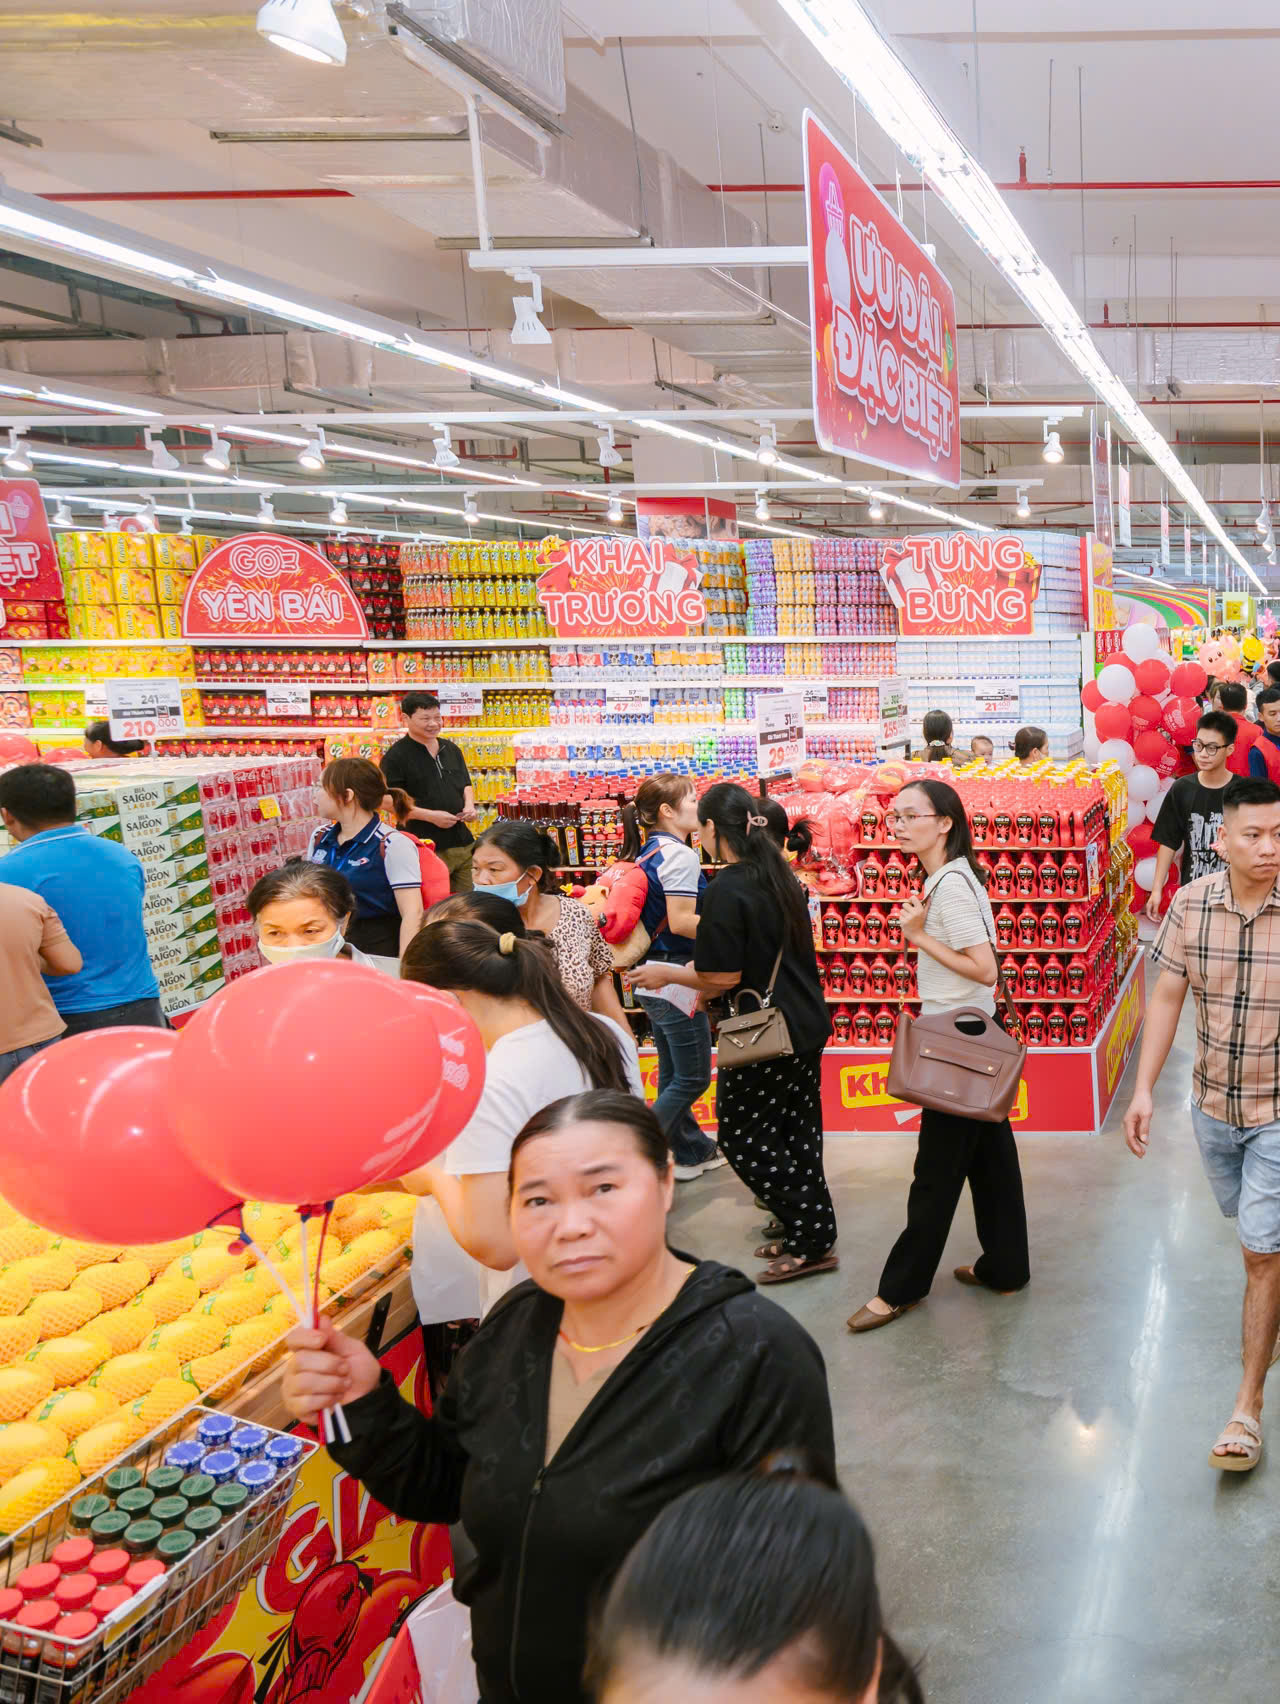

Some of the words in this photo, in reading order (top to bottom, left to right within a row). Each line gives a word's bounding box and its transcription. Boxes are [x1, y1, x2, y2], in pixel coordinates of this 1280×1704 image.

[851, 212, 896, 329] ƯU
[897, 263, 943, 372] ĐÃI
[832, 305, 900, 425] ĐẶC
[900, 355, 952, 461] BIỆT
[570, 538, 665, 575] KHAI
[904, 532, 1024, 572] TƯNG
[200, 583, 274, 622] YÊN
[280, 583, 344, 622] BÁI
[538, 587, 707, 626] TRƯƠNG
[906, 580, 1026, 622] BỪNG
[372, 659, 386, 673] C2
[403, 659, 417, 673] C2
[141, 695, 159, 704] 241
[985, 702, 997, 711] 21
[275, 705, 289, 713] 65
[375, 706, 389, 718] C2
[450, 706, 462, 714] 51
[614, 703, 628, 711] 47
[123, 720, 156, 737] 210
[769, 747, 785, 768] 29
[122, 791, 159, 805] SAIGON
[785, 805, 818, 818] HIN-SU
[126, 819, 162, 832] SAIGON
[144, 870, 170, 883] AIGON
